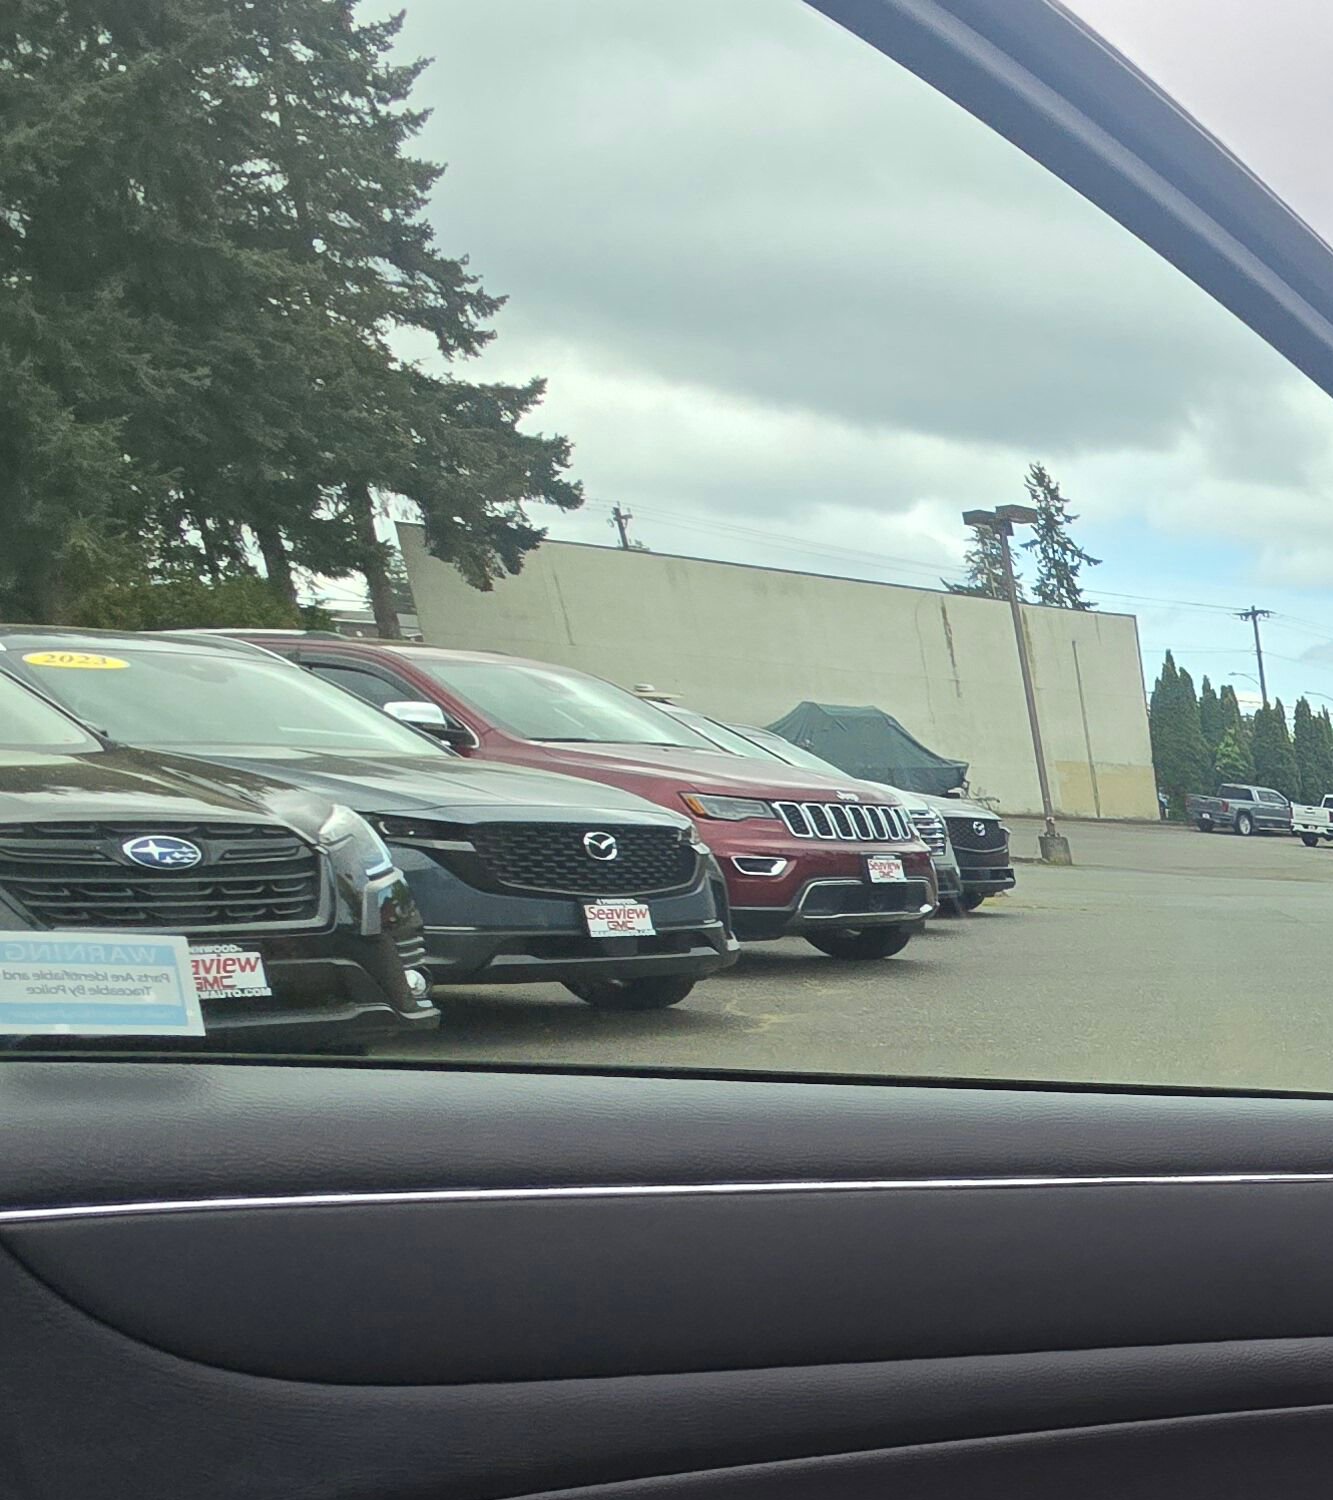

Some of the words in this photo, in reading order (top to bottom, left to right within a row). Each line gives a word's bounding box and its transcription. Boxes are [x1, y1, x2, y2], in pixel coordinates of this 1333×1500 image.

[43, 654, 108, 665] 2023
[587, 905, 648, 920] Seaview
[607, 920, 636, 931] GMC
[190, 954, 260, 975] aview
